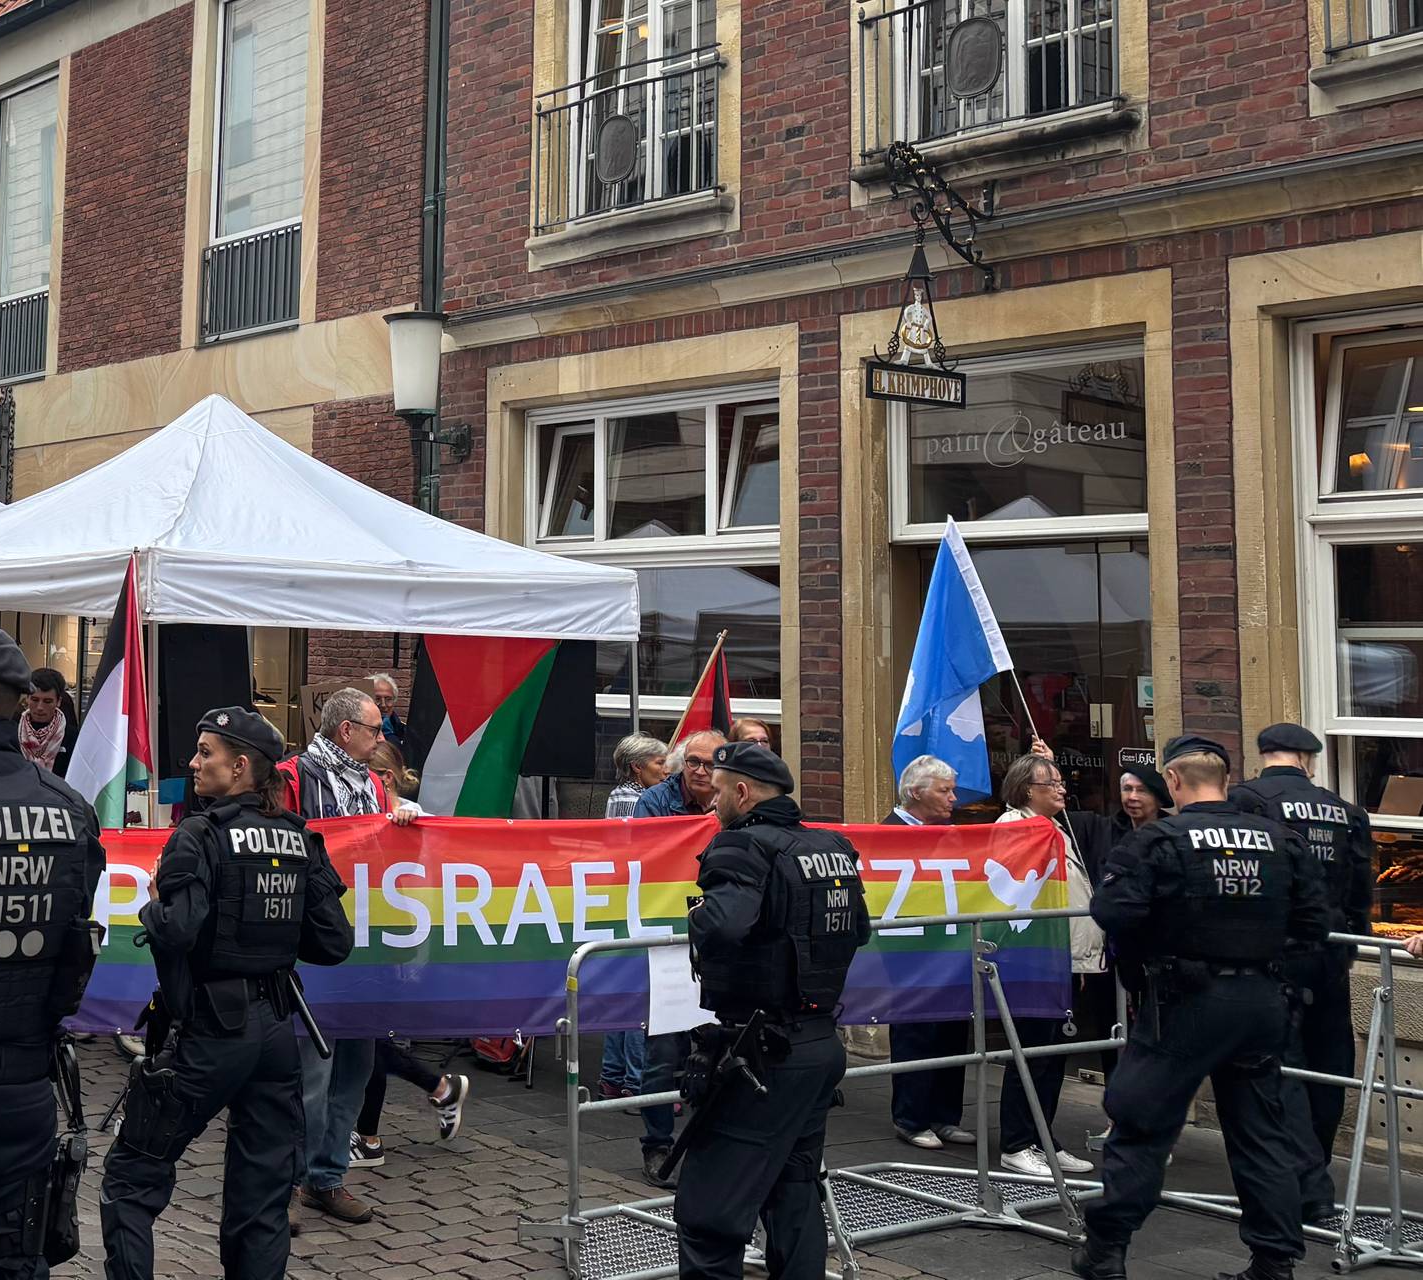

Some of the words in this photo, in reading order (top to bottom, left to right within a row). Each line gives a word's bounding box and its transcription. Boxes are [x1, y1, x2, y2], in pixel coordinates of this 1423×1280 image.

[887, 372, 962, 402] KRIMPHOVE
[927, 429, 979, 463] pain
[1033, 420, 1127, 454] gâteau
[1282, 801, 1348, 824] POLIZEI
[229, 827, 308, 858] POLIZEI
[1188, 827, 1274, 851] POLIZEI
[1308, 827, 1333, 843] NRW
[1309, 844, 1335, 861] 1112
[797, 852, 858, 880] POLIZEI
[1213, 859, 1260, 877] NRW
[257, 872, 297, 894] NRW
[1215, 878, 1263, 896] 1512
[264, 898, 292, 919] 1511
[354, 860, 674, 948] ISRAEL
[827, 888, 849, 908] NRW
[825, 911, 851, 933] 1511
